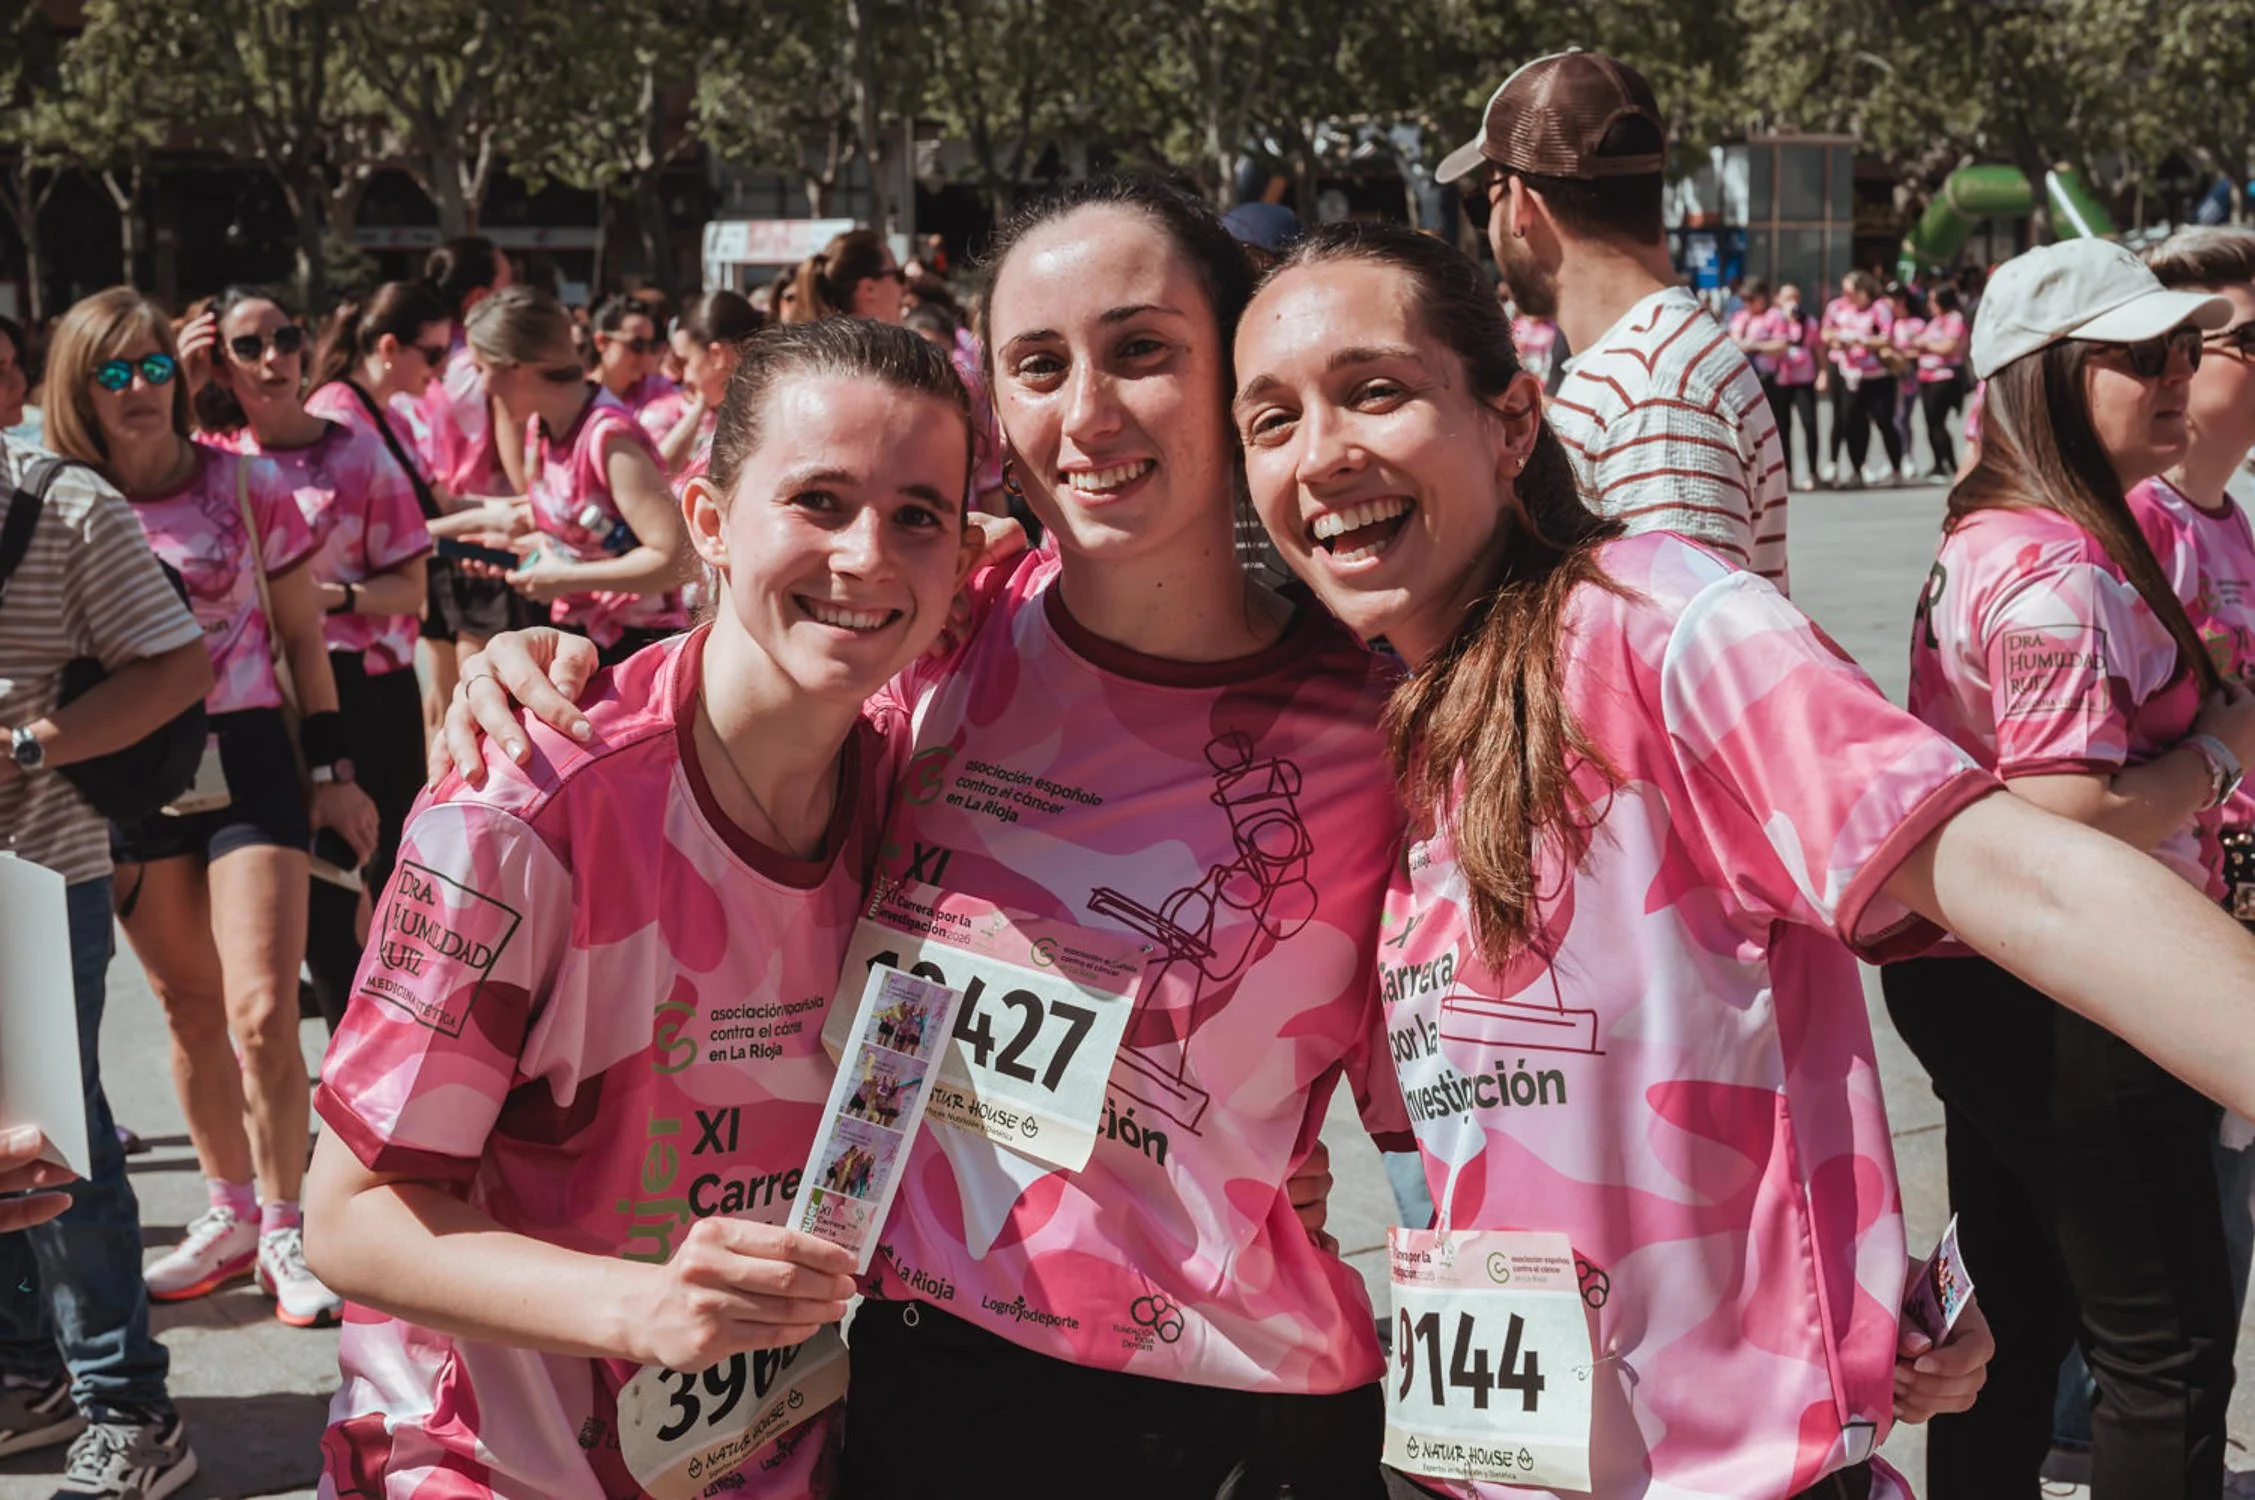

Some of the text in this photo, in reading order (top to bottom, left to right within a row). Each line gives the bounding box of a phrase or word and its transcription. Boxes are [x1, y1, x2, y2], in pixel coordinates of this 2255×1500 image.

[956, 776, 1065, 814] contra el cáncer
[965, 759, 1103, 806] asociación española
[945, 793, 1019, 822] en La Rioja
[903, 842, 952, 887] XI
[398, 870, 435, 906] DRA
[897, 896, 934, 917] Carrera
[935, 910, 958, 925] por
[959, 913, 972, 928] la
[710, 1003, 784, 1021] asociación
[866, 949, 1098, 1094] 427
[710, 1024, 754, 1042] contra
[758, 1023, 772, 1038] el
[709, 1041, 783, 1061] en La Rioja
[968, 1099, 1019, 1129] HOUSE
[691, 1107, 741, 1156] XI
[1097, 1097, 1169, 1167] ión
[911, 1268, 955, 1301] Rioja
[1399, 1307, 1545, 1412] 9144
[1422, 1440, 1513, 1467] NATUR HOUSE
